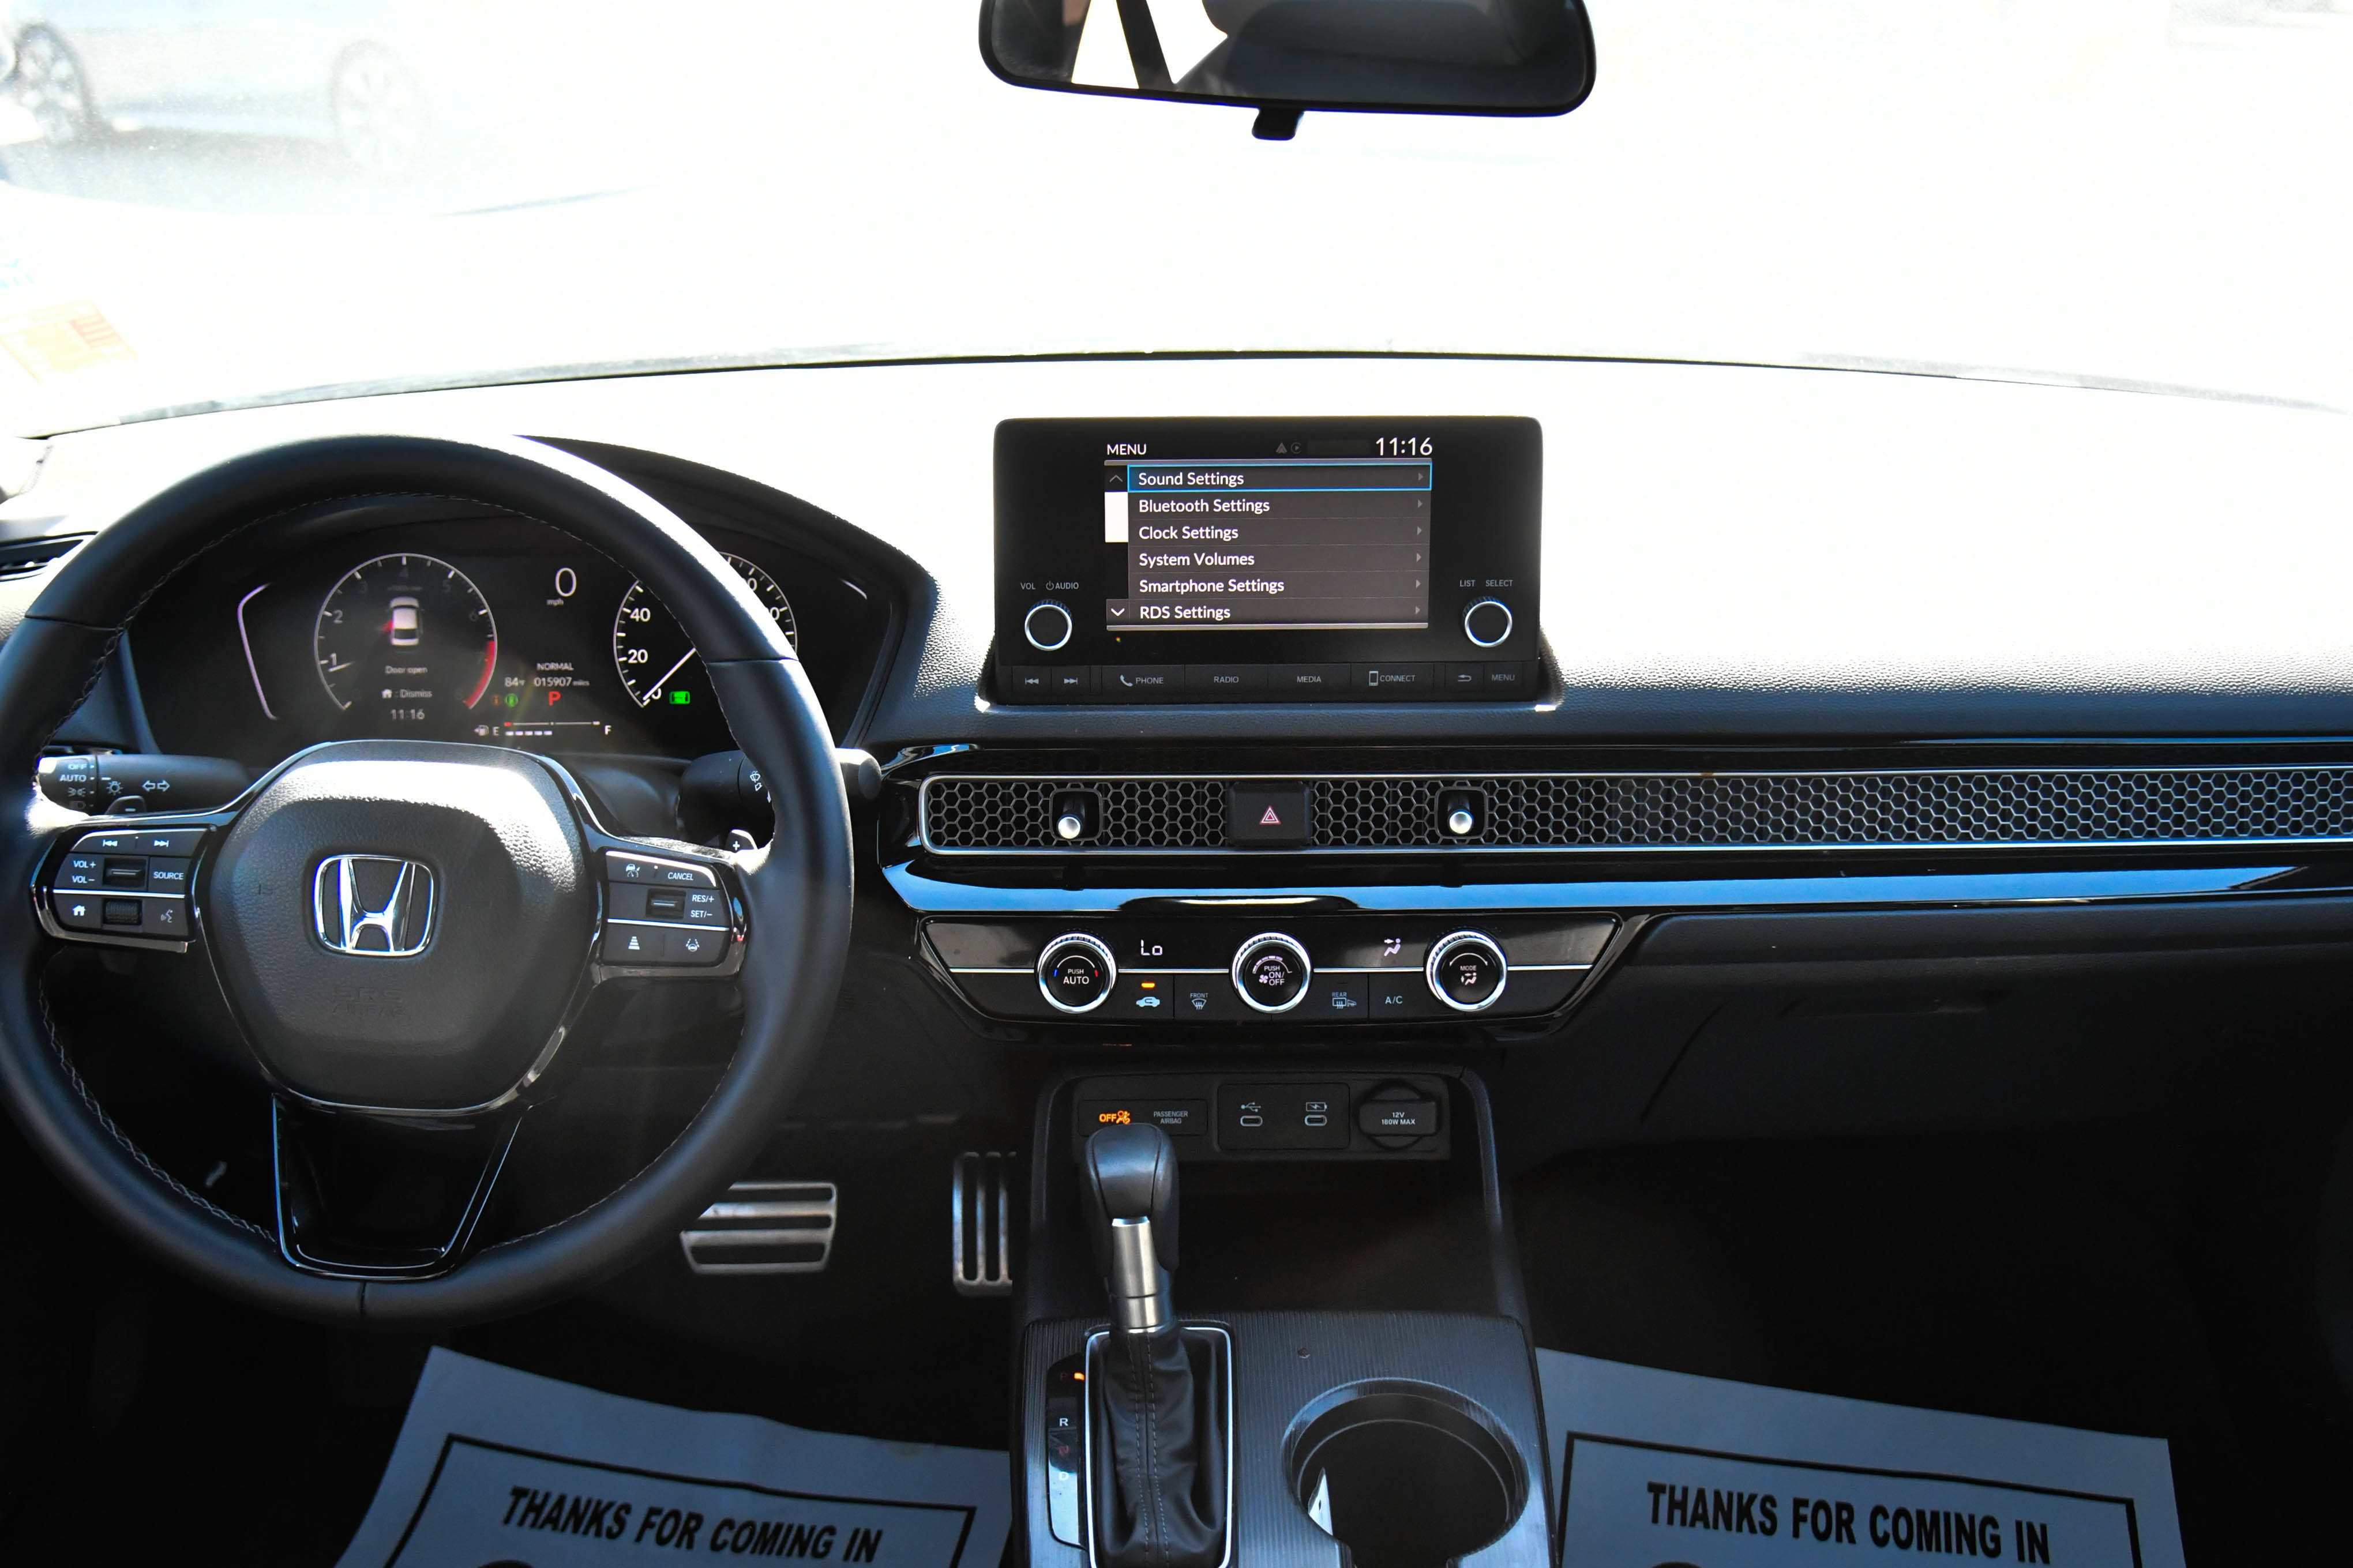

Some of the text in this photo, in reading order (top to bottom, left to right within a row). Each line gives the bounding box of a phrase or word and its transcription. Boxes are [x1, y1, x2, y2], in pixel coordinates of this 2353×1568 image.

[1108, 444, 1146, 454] MENU
[1376, 437, 1432, 456] 11:16
[1139, 472, 1244, 488] Sound Settings
[1139, 499, 1269, 514] Bluetooth Settings
[1139, 526, 1238, 541] Clock Settings
[1139, 552, 1254, 568] System Volumes
[556, 567, 576, 596] 0
[1139, 579, 1284, 595] Smartphone Settings
[333, 610, 343, 623] 2
[630, 608, 651, 622] 40
[1140, 606, 1230, 621] RDS Settings
[628, 649, 648, 663] 20
[385, 665, 406, 674] Door
[534, 676, 572, 687] 015907
[400, 689, 432, 698] Dismiss
[549, 691, 560, 705] P
[392, 709, 425, 720] 11:16
[493, 727, 499, 735] E
[605, 725, 611, 735] F
[153, 871, 183, 879] SOURCE
[667, 871, 693, 881] CANCEL
[692, 894, 714, 903] RES/+
[1099, 1113, 1116, 1123] OFF
[1060, 1418, 1068, 1426] R
[1059, 1472, 1068, 1481] D
[503, 1486, 882, 1563] THANKS FOR COMING IN
[1648, 1481, 2050, 1565] THANKS FOR COMING IN
